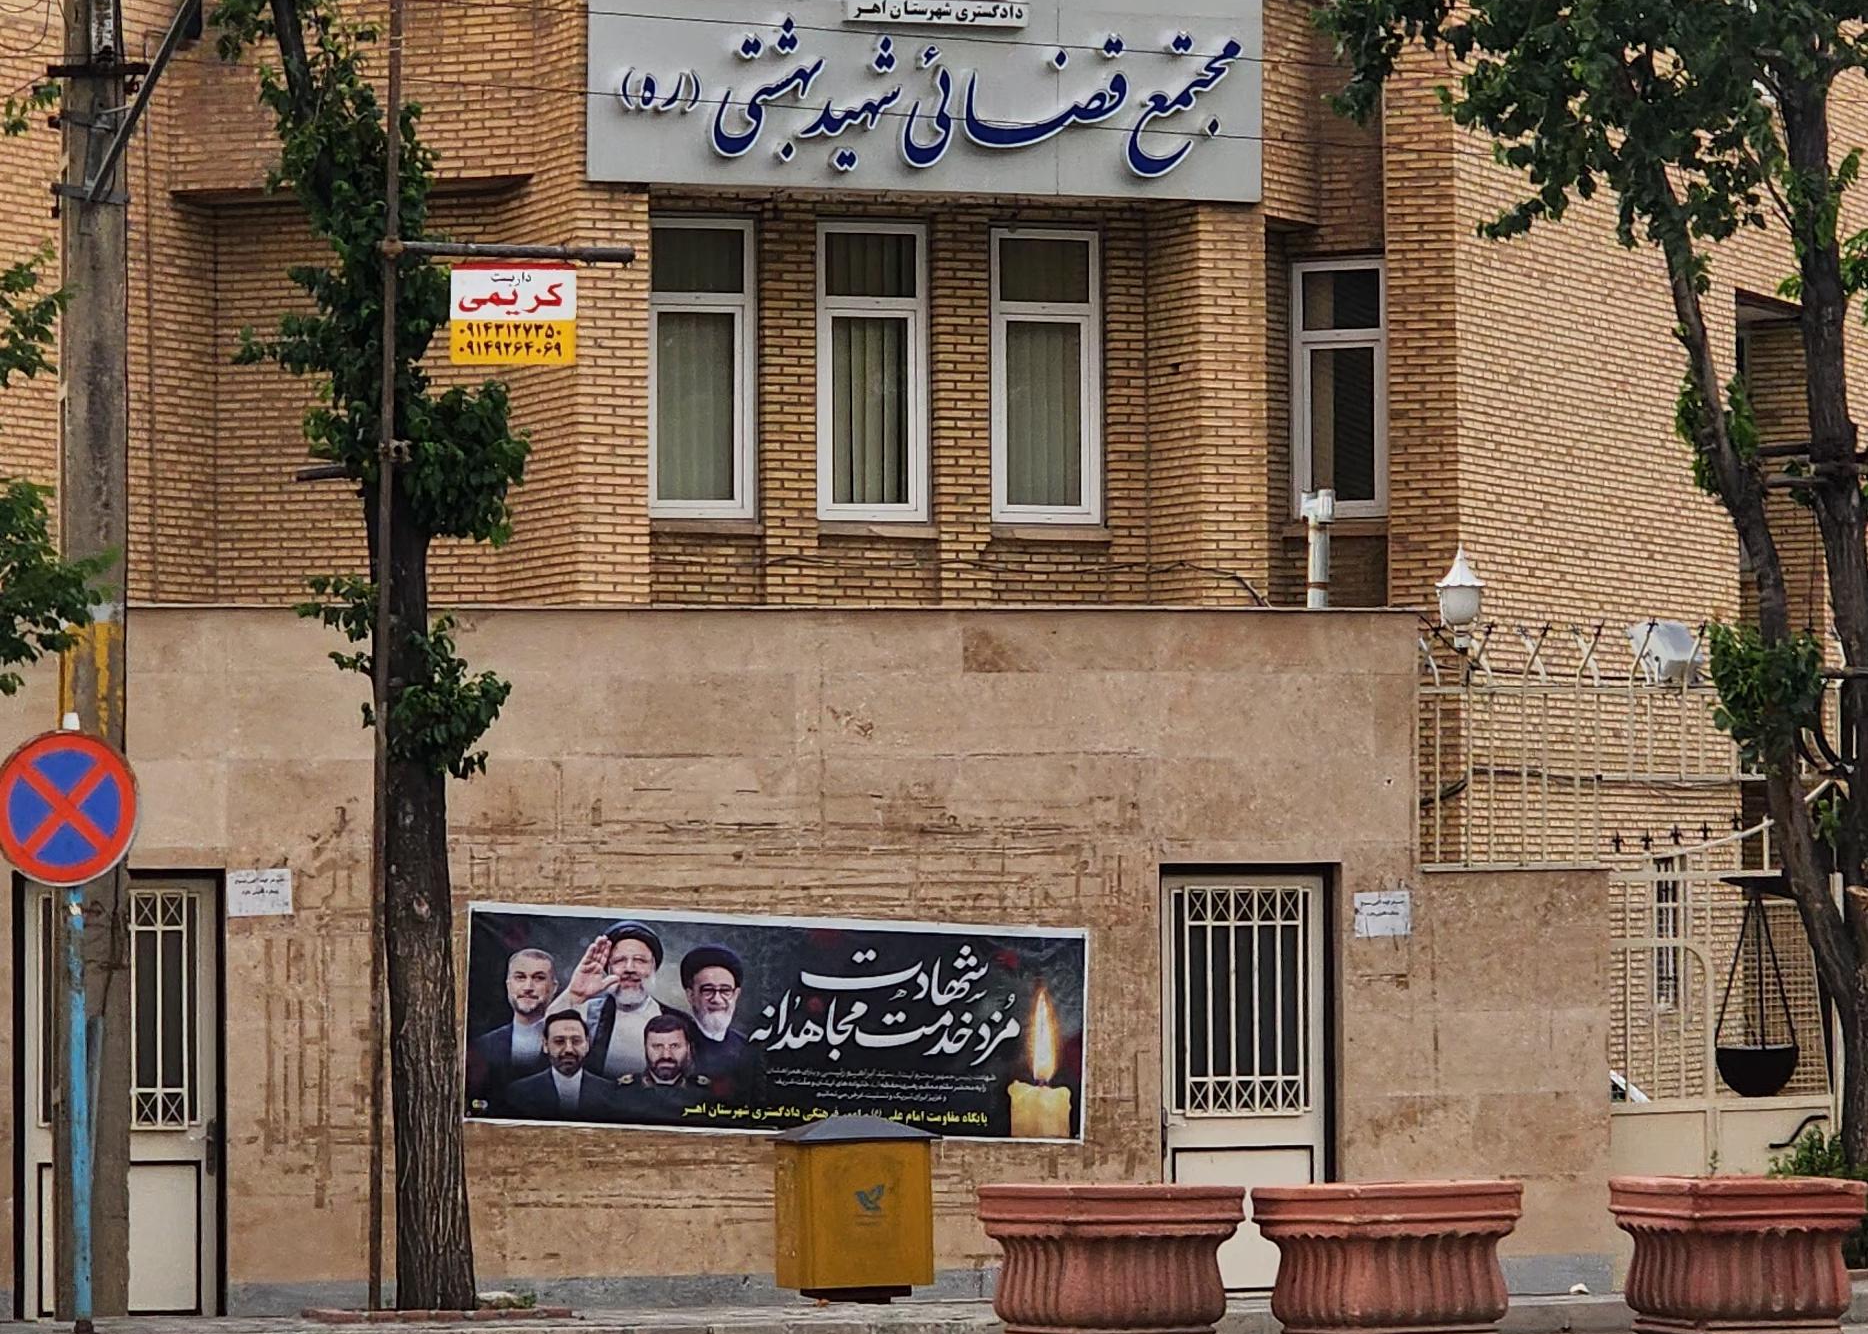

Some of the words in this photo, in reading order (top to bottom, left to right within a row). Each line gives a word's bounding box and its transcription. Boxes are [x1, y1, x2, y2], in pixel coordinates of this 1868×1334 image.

[853, 0, 887, 18] اهر
[889, 0, 951, 21] شهرستان
[956, 3, 1024, 23] دادگستری
[620, 67, 702, 111] (ره)
[711, 14, 826, 163] بهشتی
[800, 34, 902, 172] شهید
[1126, 31, 1242, 178] مجتمع
[458, 282, 564, 316] کریمی
[800, 944, 990, 1007] شهادت
[748, 988, 869, 1062] مجاهدانه
[854, 1010, 974, 1057] خدمت
[681, 1101, 706, 1117] اهر
[707, 1102, 750, 1120] شهرستان
[751, 1104, 800, 1121] دادگستری
[905, 1109, 925, 1126] امام
[926, 1110, 960, 1126] مقاومت
[961, 1111, 988, 1127] پایگاه
